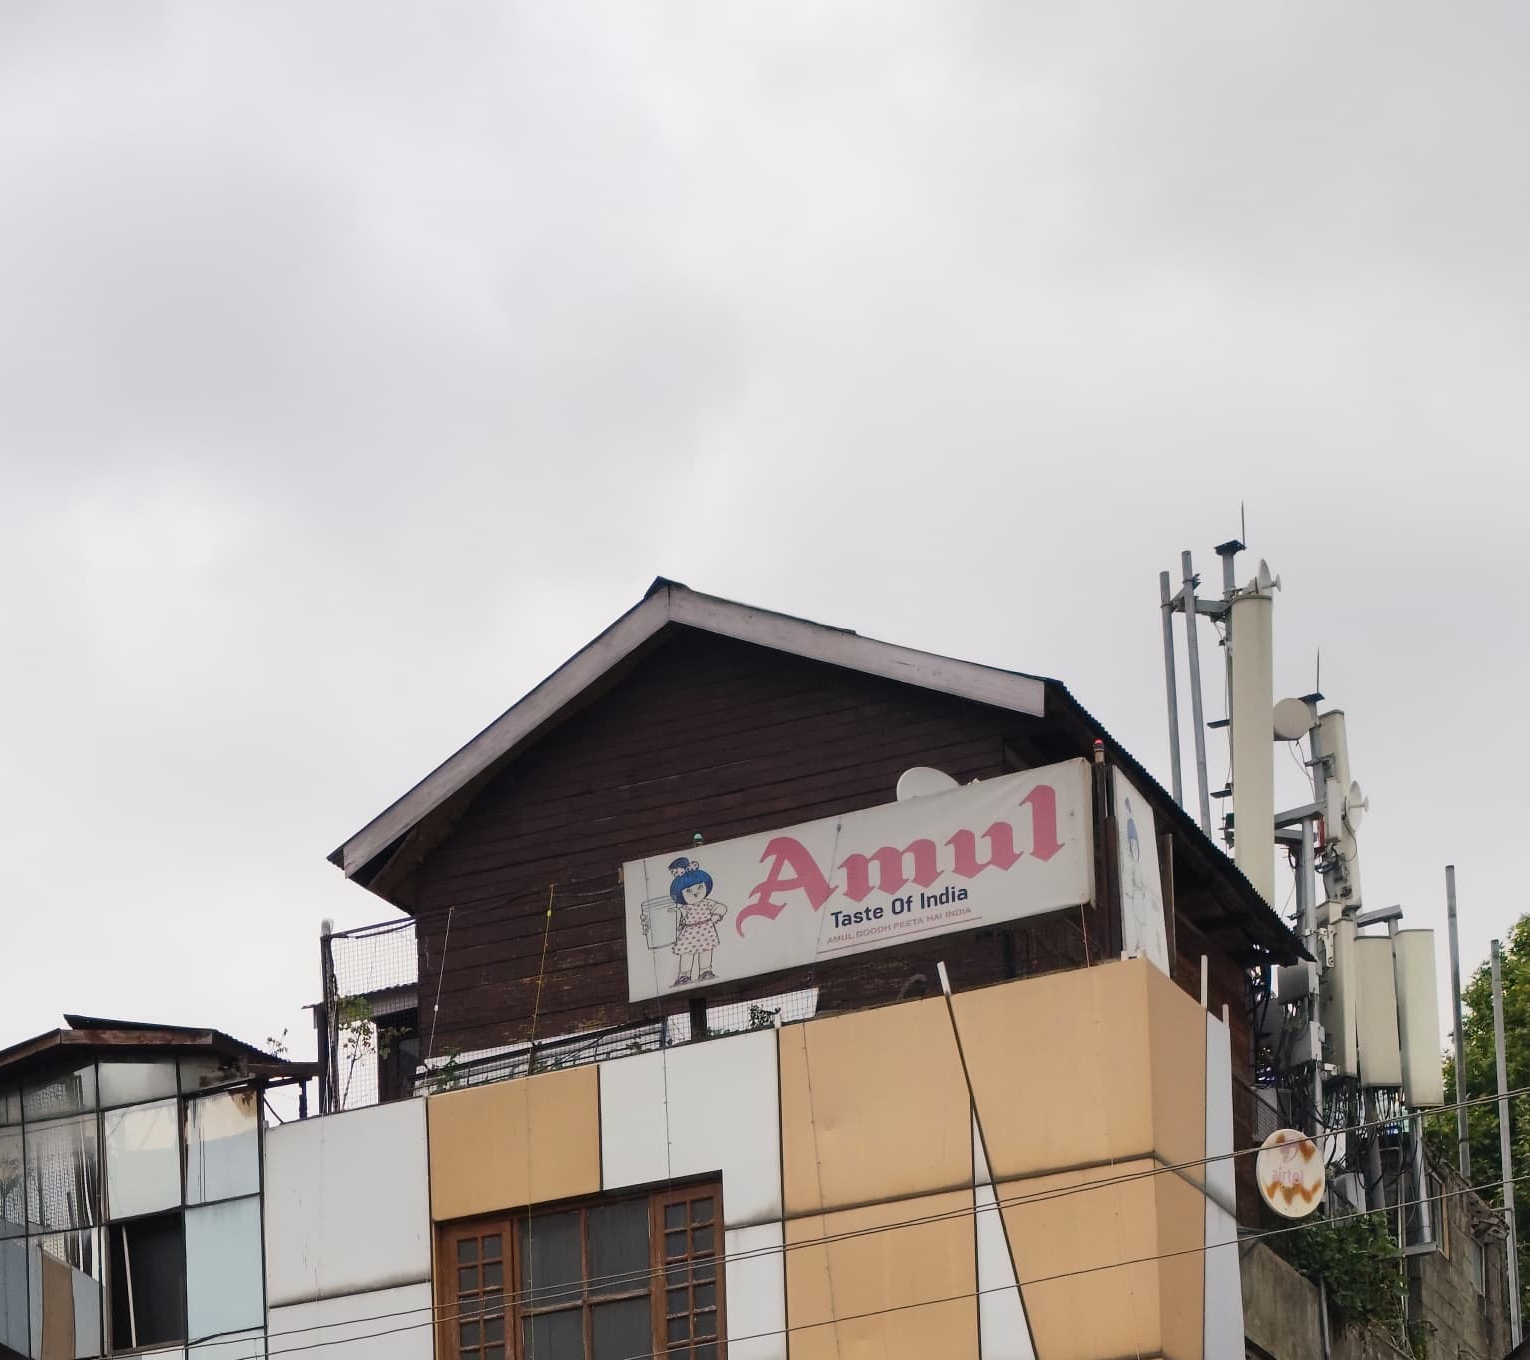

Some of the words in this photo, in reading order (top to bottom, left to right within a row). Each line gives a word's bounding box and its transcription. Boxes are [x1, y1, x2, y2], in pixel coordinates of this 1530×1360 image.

[735, 784, 1066, 939] Amul
[827, 933, 854, 945] AMUL
[926, 913, 943, 923] HAI
[945, 907, 972, 919] INDIA
[830, 906, 884, 929] Taste
[891, 895, 914, 916] Of
[920, 886, 969, 910] India
[1271, 1167, 1304, 1185] airtel
